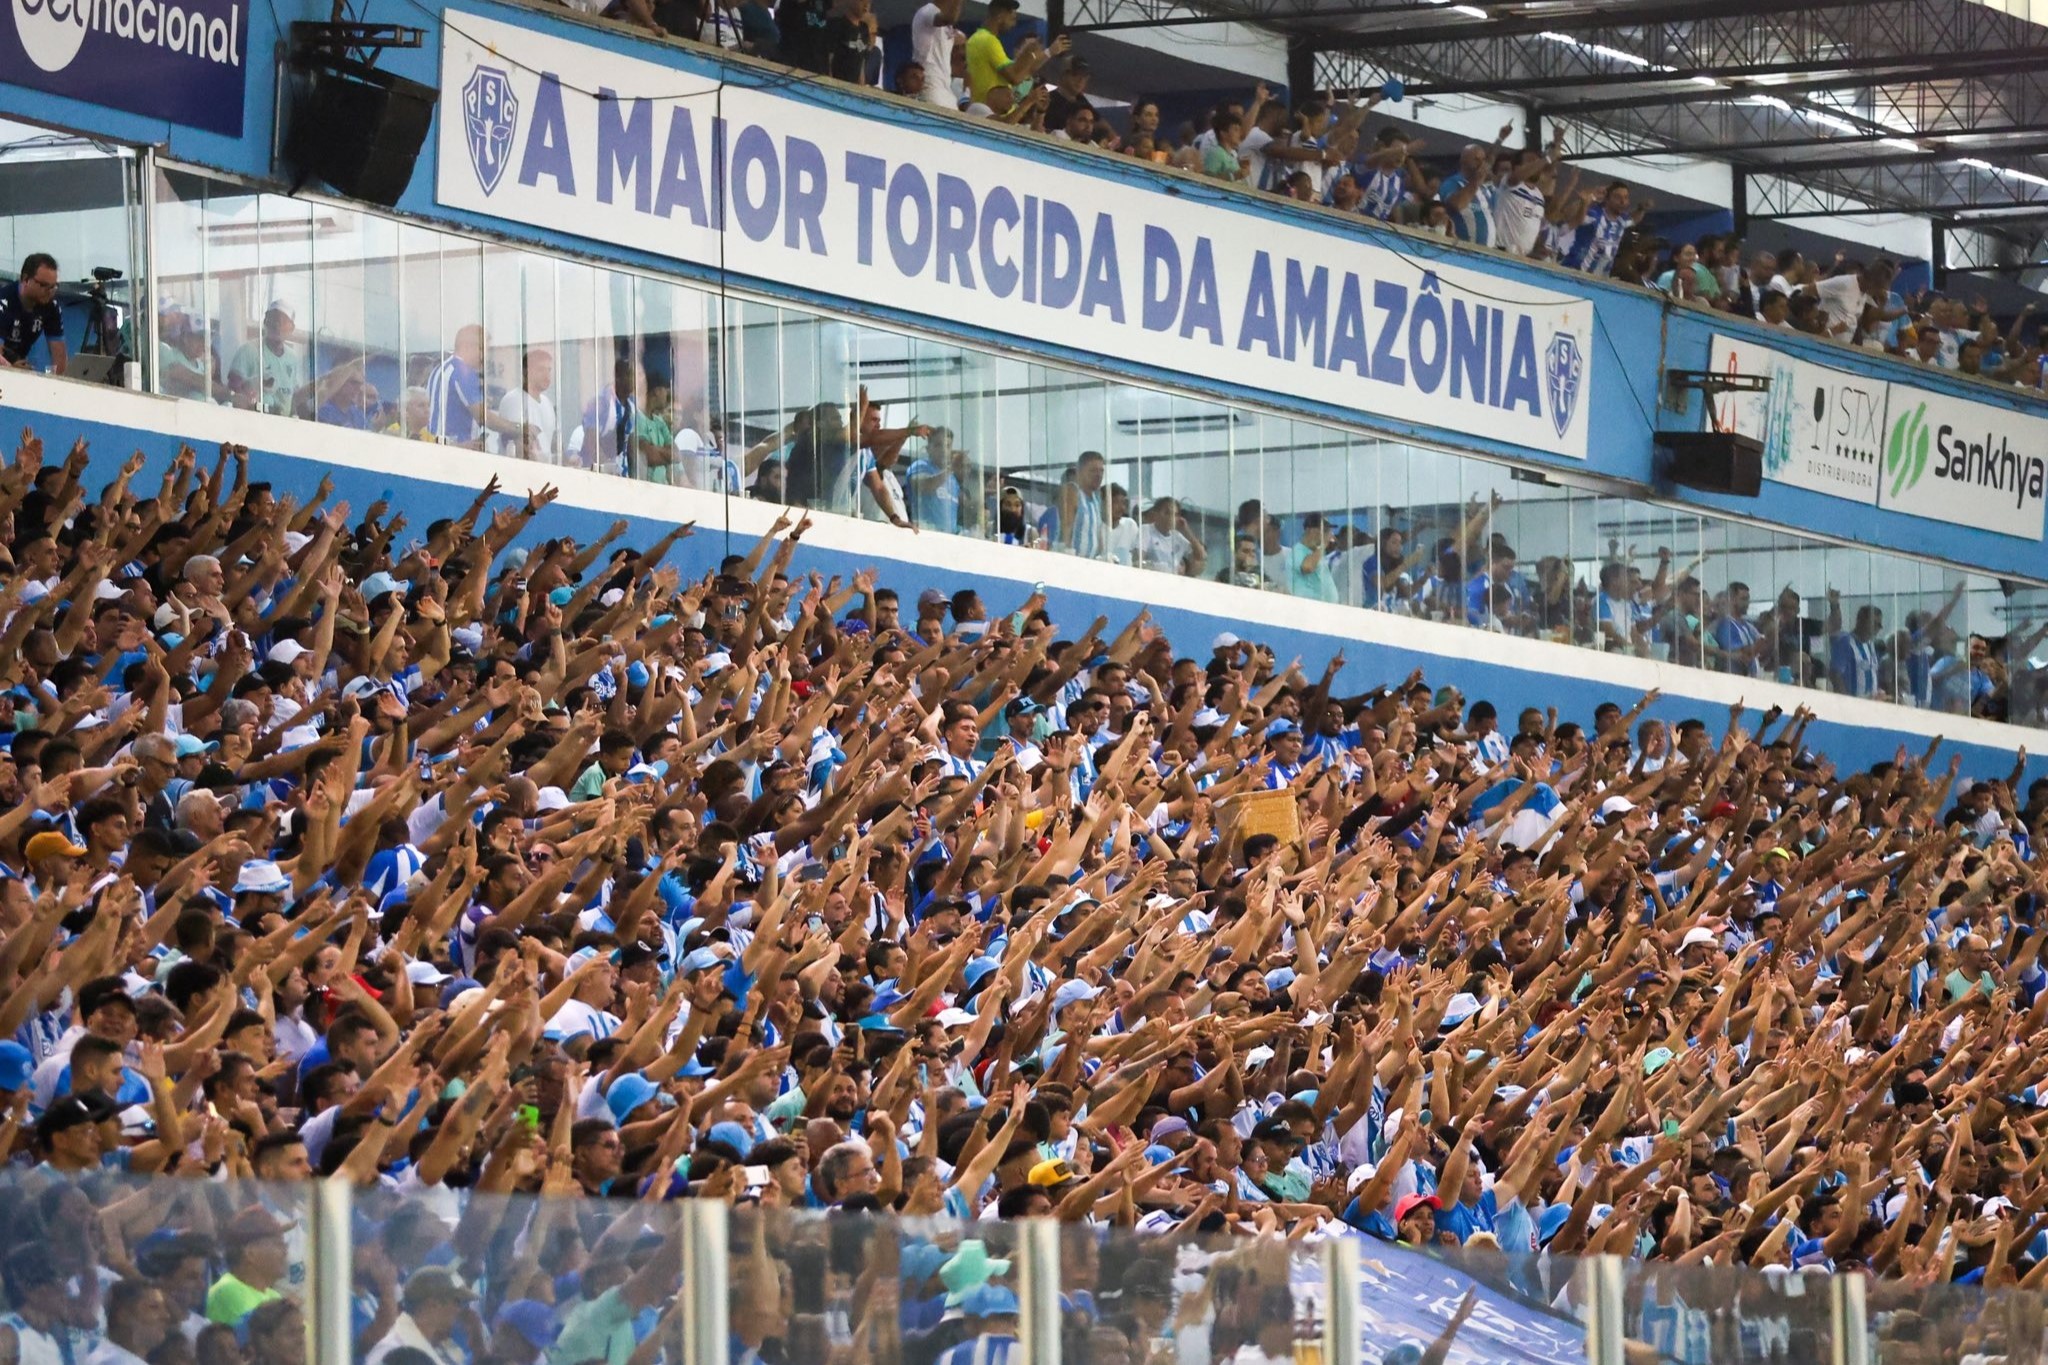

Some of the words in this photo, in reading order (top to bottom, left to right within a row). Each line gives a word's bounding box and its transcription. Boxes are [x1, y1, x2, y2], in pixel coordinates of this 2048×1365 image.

[20, 0, 239, 67] nacional
[518, 70, 577, 197] A
[596, 85, 829, 257] MAIOR
[845, 150, 1126, 325] TORCIDA
[1142, 223, 1224, 347] DA
[1237, 249, 1542, 418] AMAZÔNIA
[1837, 386, 1880, 443] STX
[1807, 459, 1873, 487] DISTRIBUIDORA
[1934, 424, 2045, 510] Sankhya
